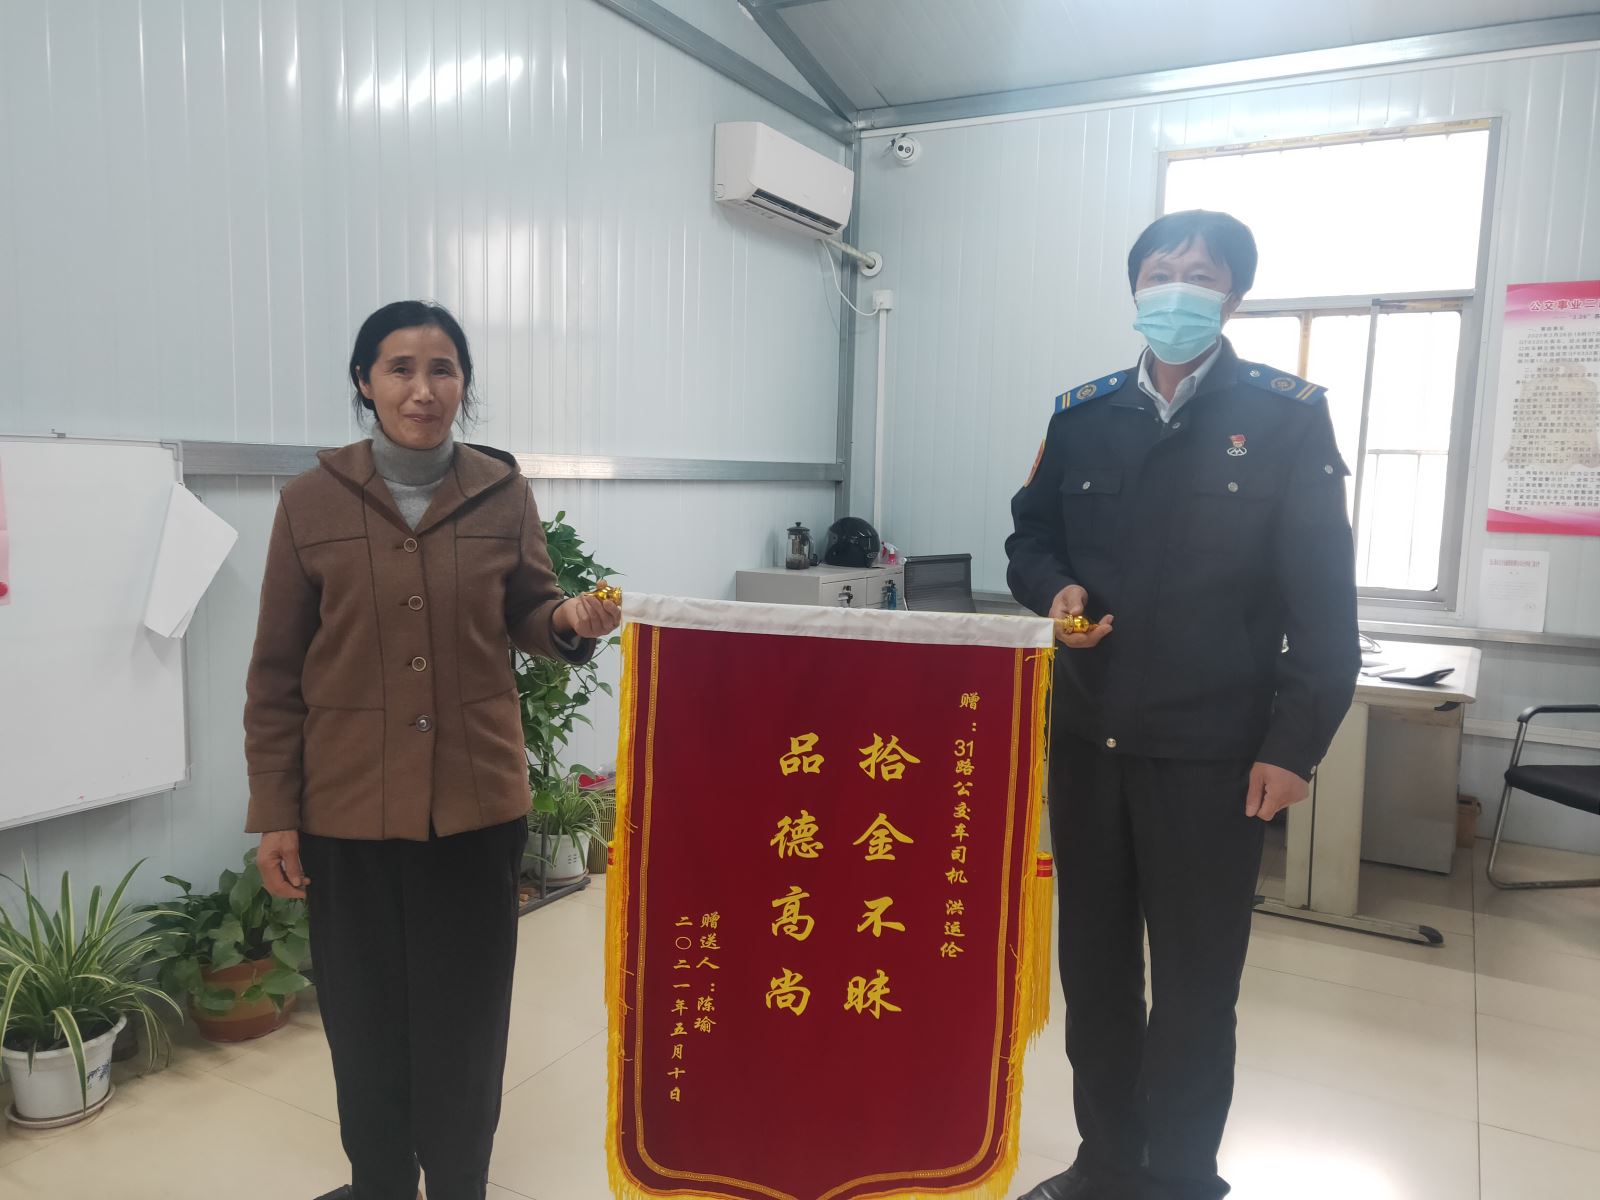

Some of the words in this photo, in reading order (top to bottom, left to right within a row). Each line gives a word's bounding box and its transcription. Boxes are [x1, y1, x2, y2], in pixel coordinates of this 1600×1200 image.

[1529, 299, 1600, 312] 公交事业二
[765, 732, 825, 1016] 品德高尚
[843, 732, 921, 1020] 拾金不昧
